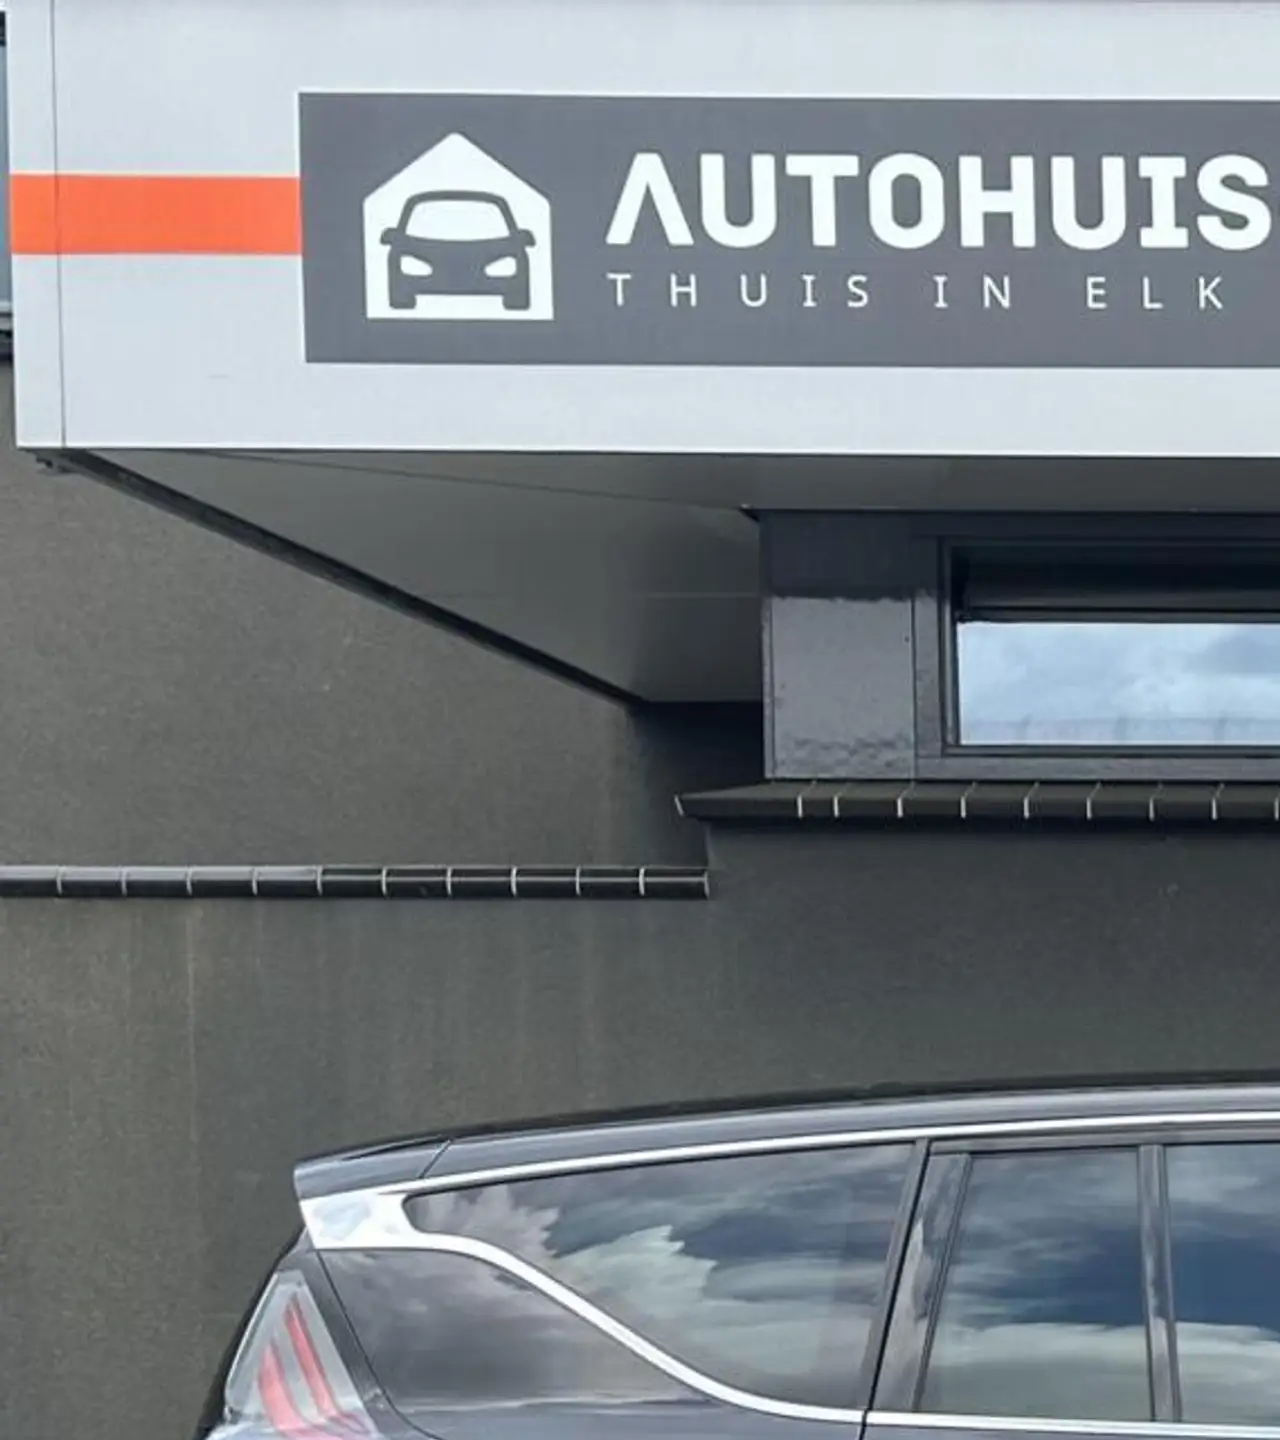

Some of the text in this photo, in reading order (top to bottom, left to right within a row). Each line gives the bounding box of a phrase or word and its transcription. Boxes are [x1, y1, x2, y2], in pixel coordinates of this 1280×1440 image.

[605, 271, 871, 309] THUIS
[932, 273, 1012, 310] IN
[1085, 275, 1224, 311] ELK
